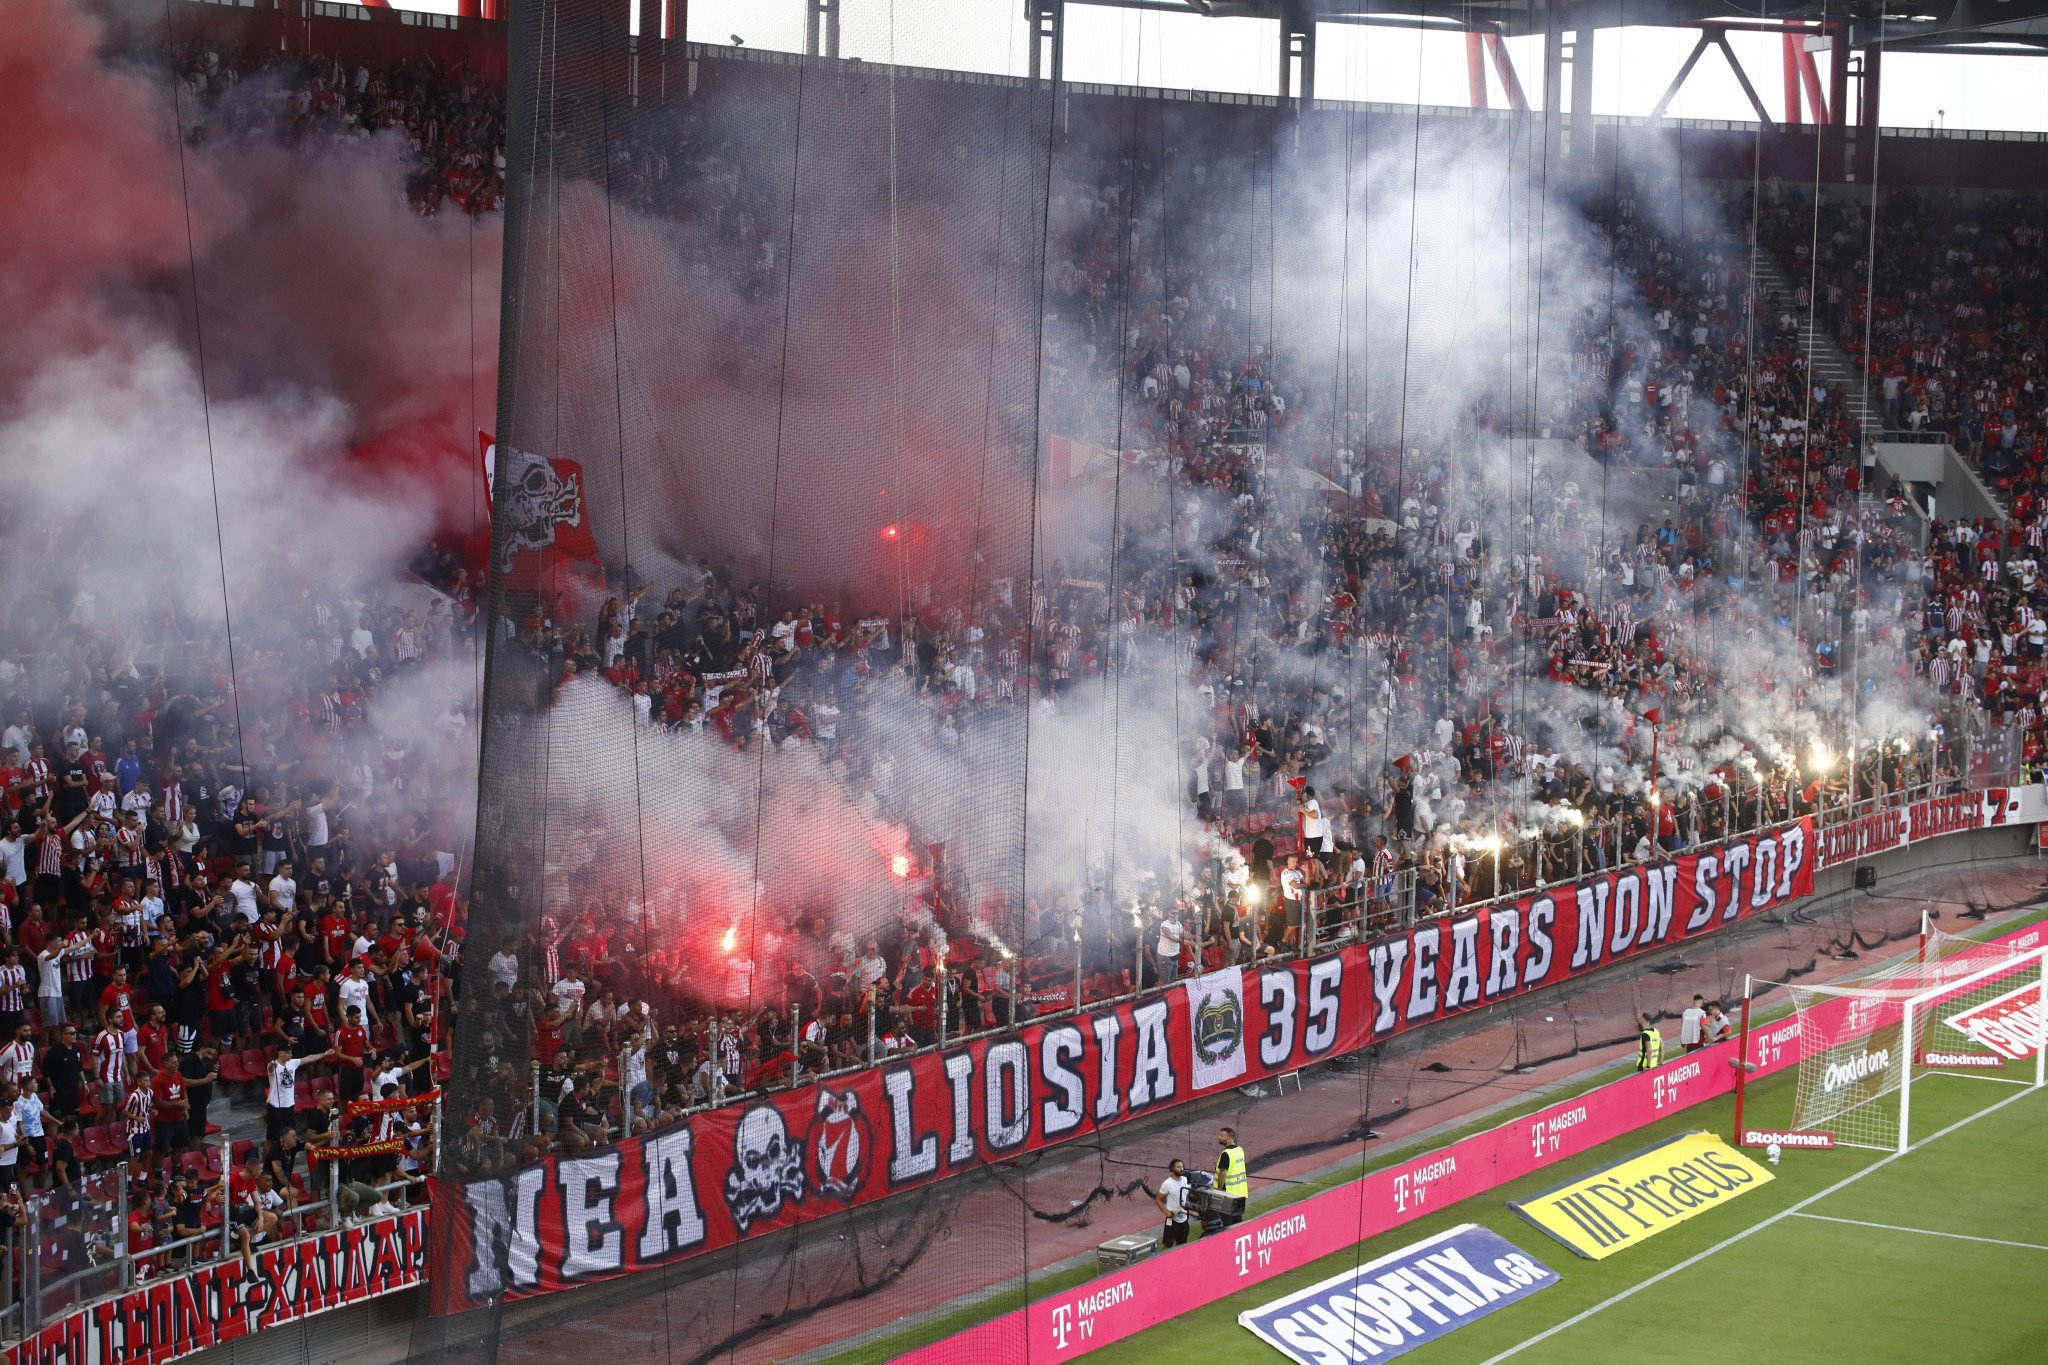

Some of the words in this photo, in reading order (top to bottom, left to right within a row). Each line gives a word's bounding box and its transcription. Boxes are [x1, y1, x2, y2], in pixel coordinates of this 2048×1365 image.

[885, 1000, 1175, 1181] LIOSIA
[1260, 959, 1342, 1065] 35
[1369, 904, 1554, 1033] YEARS
[1572, 865, 1678, 968] NON
[1688, 826, 1804, 929] STOP
[1772, 1022, 1801, 1046] MAGENTA
[1772, 1047, 1781, 1062] TV
[1925, 1053, 1998, 1066] Stoiximan
[1668, 1061, 1700, 1086] MAGENTA
[1668, 1087, 1677, 1103] TV
[1549, 1107, 1587, 1134] MAGENTA
[1549, 1134, 1561, 1152] TV
[1745, 1131, 1828, 1146] Stoiximan
[1414, 1157, 1457, 1187] MAGENTA
[1414, 1187, 1426, 1206] TV
[1584, 1151, 1754, 1229] Piraeus
[1257, 1214, 1307, 1248] MAGENTA
[1257, 1247, 1272, 1268] TV
[1078, 1280, 1134, 1319] MAGENTA
[1078, 1318, 1094, 1340] TV
